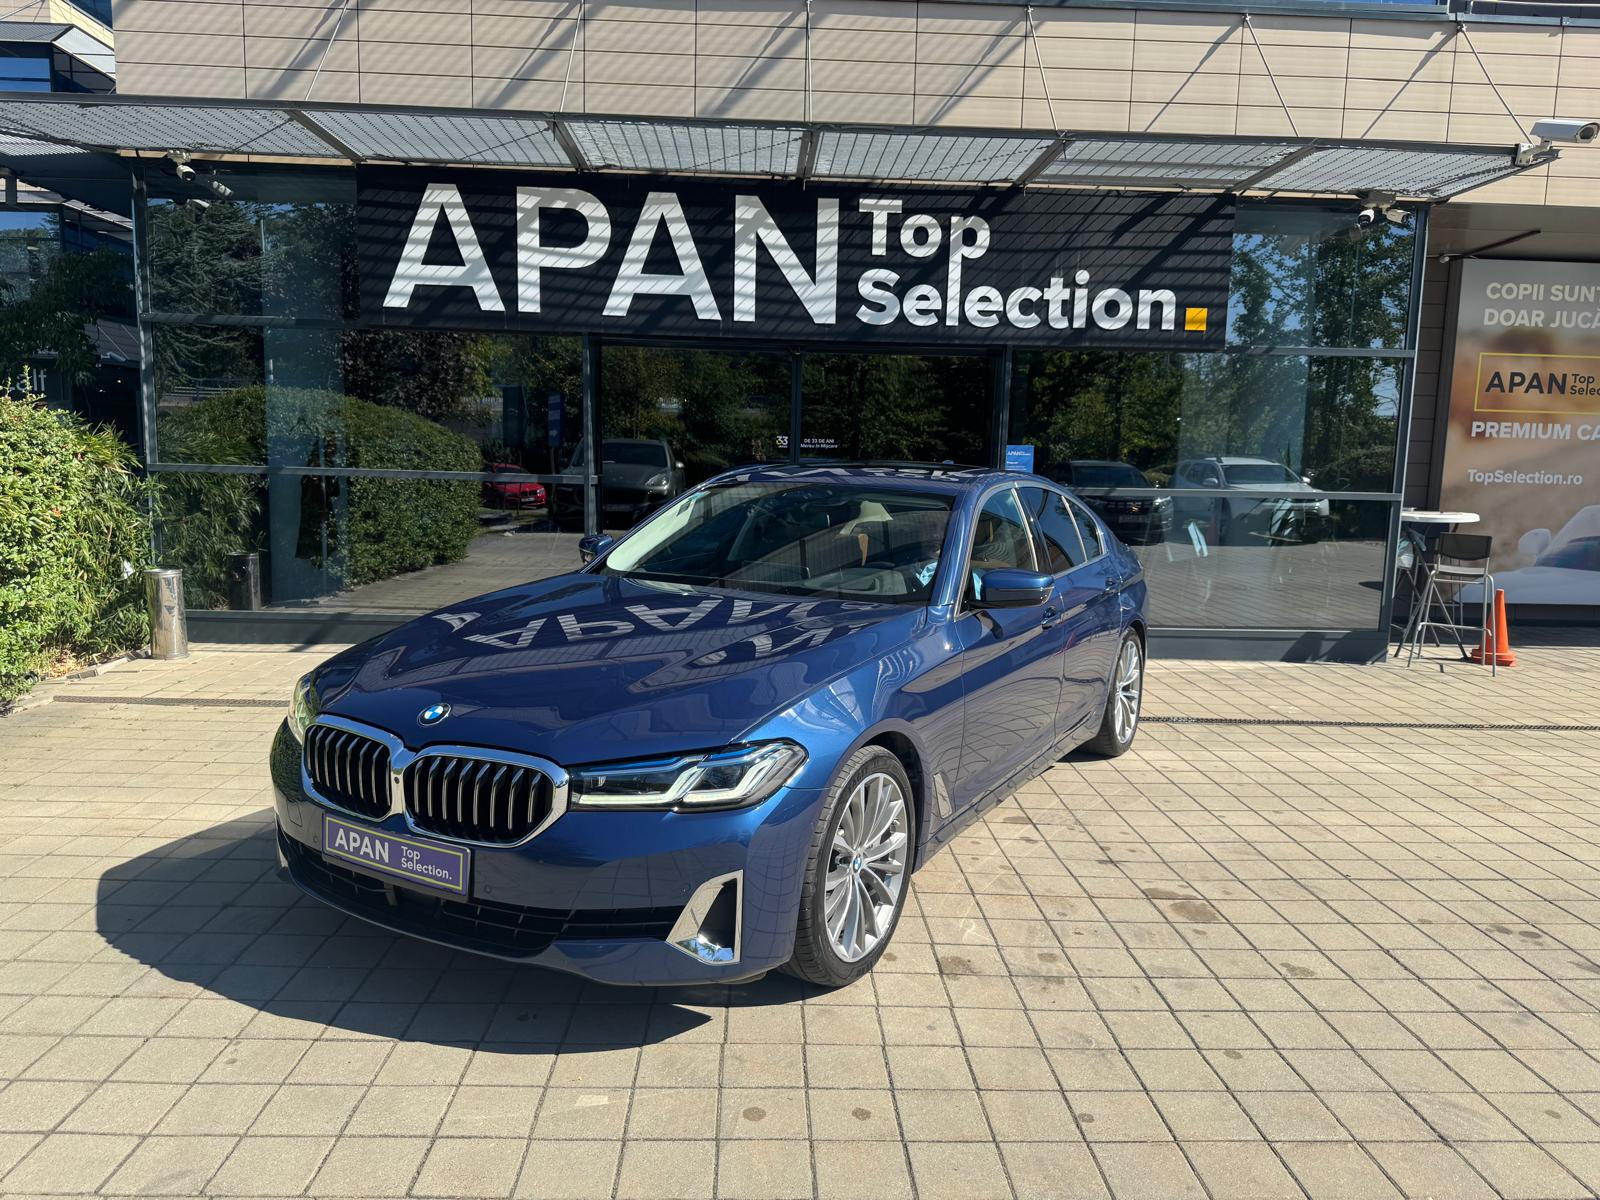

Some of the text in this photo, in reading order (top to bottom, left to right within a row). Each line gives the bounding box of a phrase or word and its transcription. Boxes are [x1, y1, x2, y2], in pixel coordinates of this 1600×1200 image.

[858, 198, 991, 260] Top
[382, 183, 840, 324] APAN
[1486, 282, 1600, 302] COPII SUN
[1483, 308, 1544, 328] DOAR
[1485, 371, 1567, 394] APAN
[1571, 373, 1595, 386] Top
[1471, 421, 1571, 440] PREMIUM
[1467, 469, 1583, 486] TopSelection.ro
[335, 828, 389, 863] APAN
[401, 845, 420, 861] Top
[401, 858, 453, 880] Selection.
